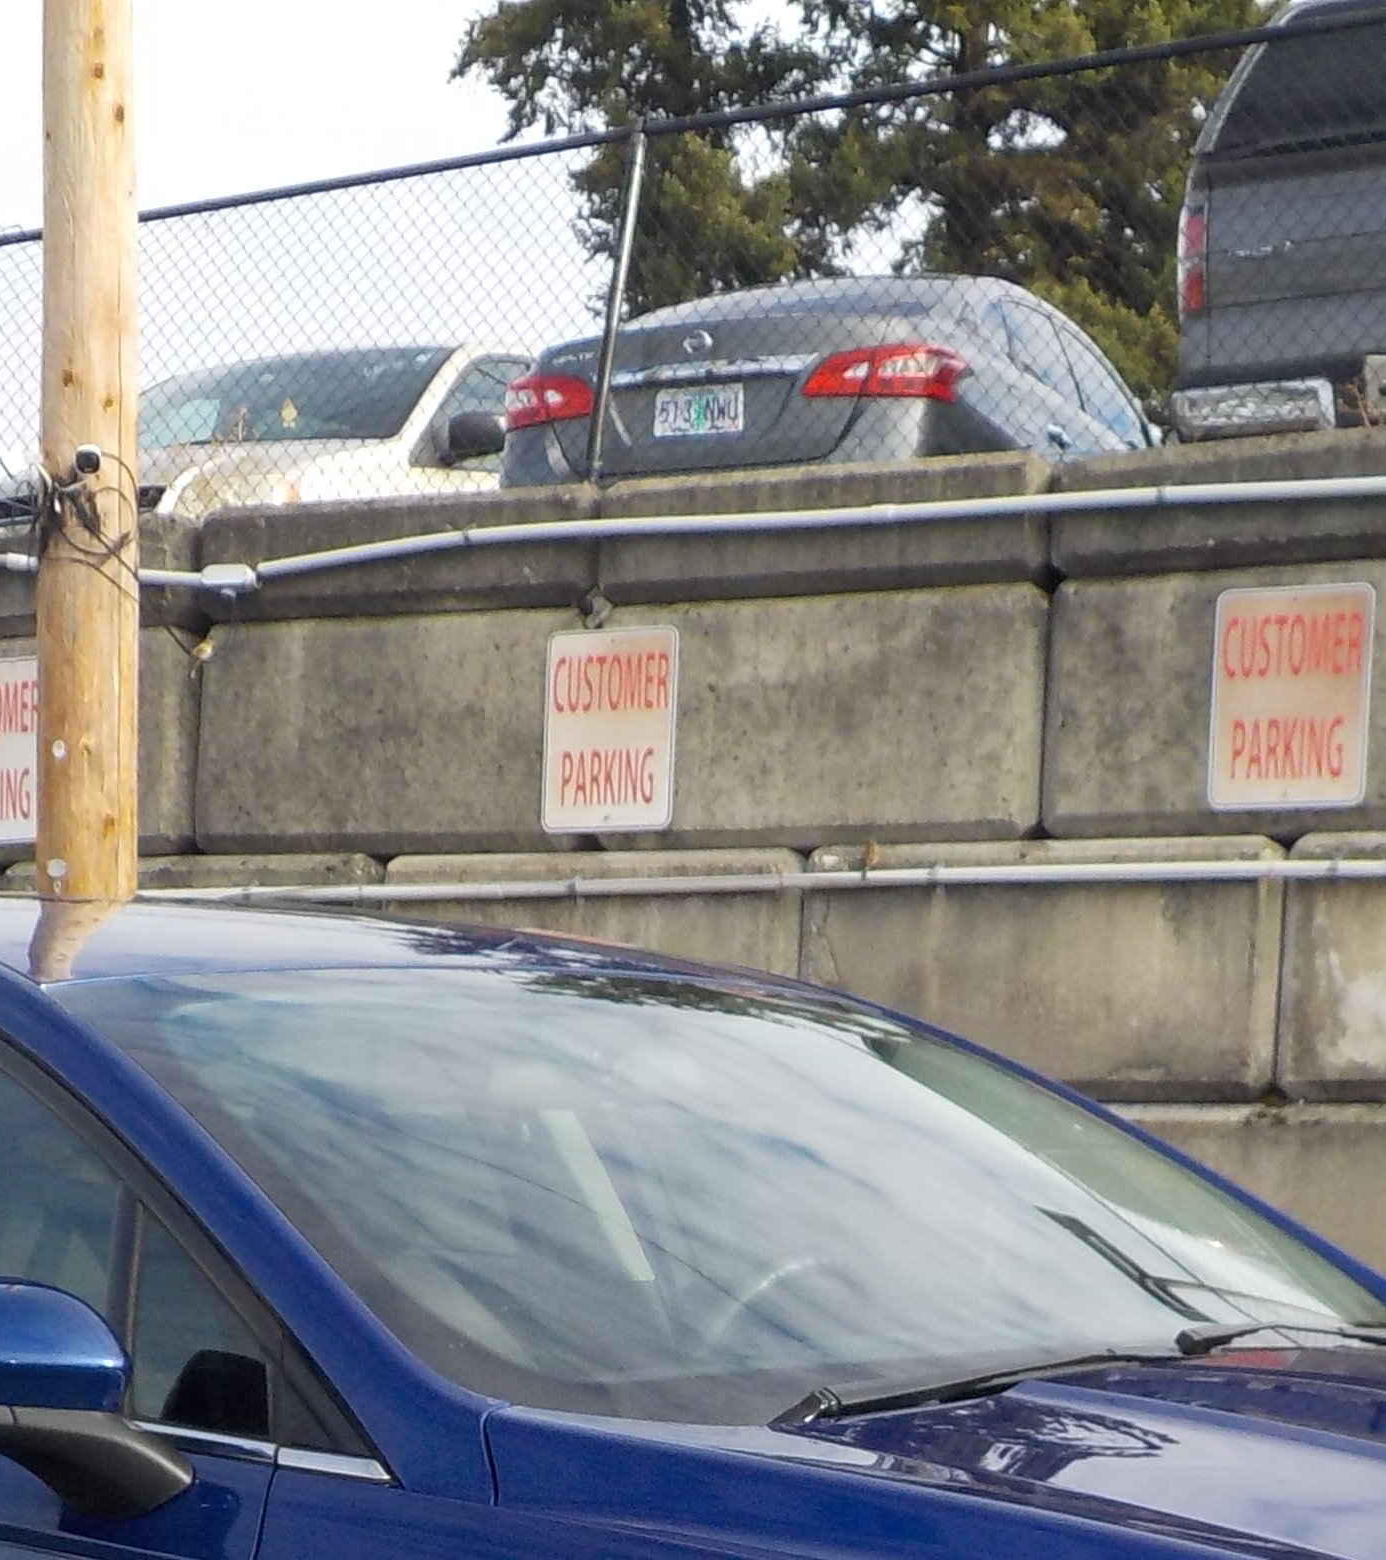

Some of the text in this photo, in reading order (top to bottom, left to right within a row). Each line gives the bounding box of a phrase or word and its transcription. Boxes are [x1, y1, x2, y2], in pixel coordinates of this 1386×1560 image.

[1223, 611, 1364, 678] CUSTOMER
[553, 651, 669, 713] CUSTOMER
[560, 747, 654, 806] PARKING
[1230, 715, 1345, 780] PARKING
